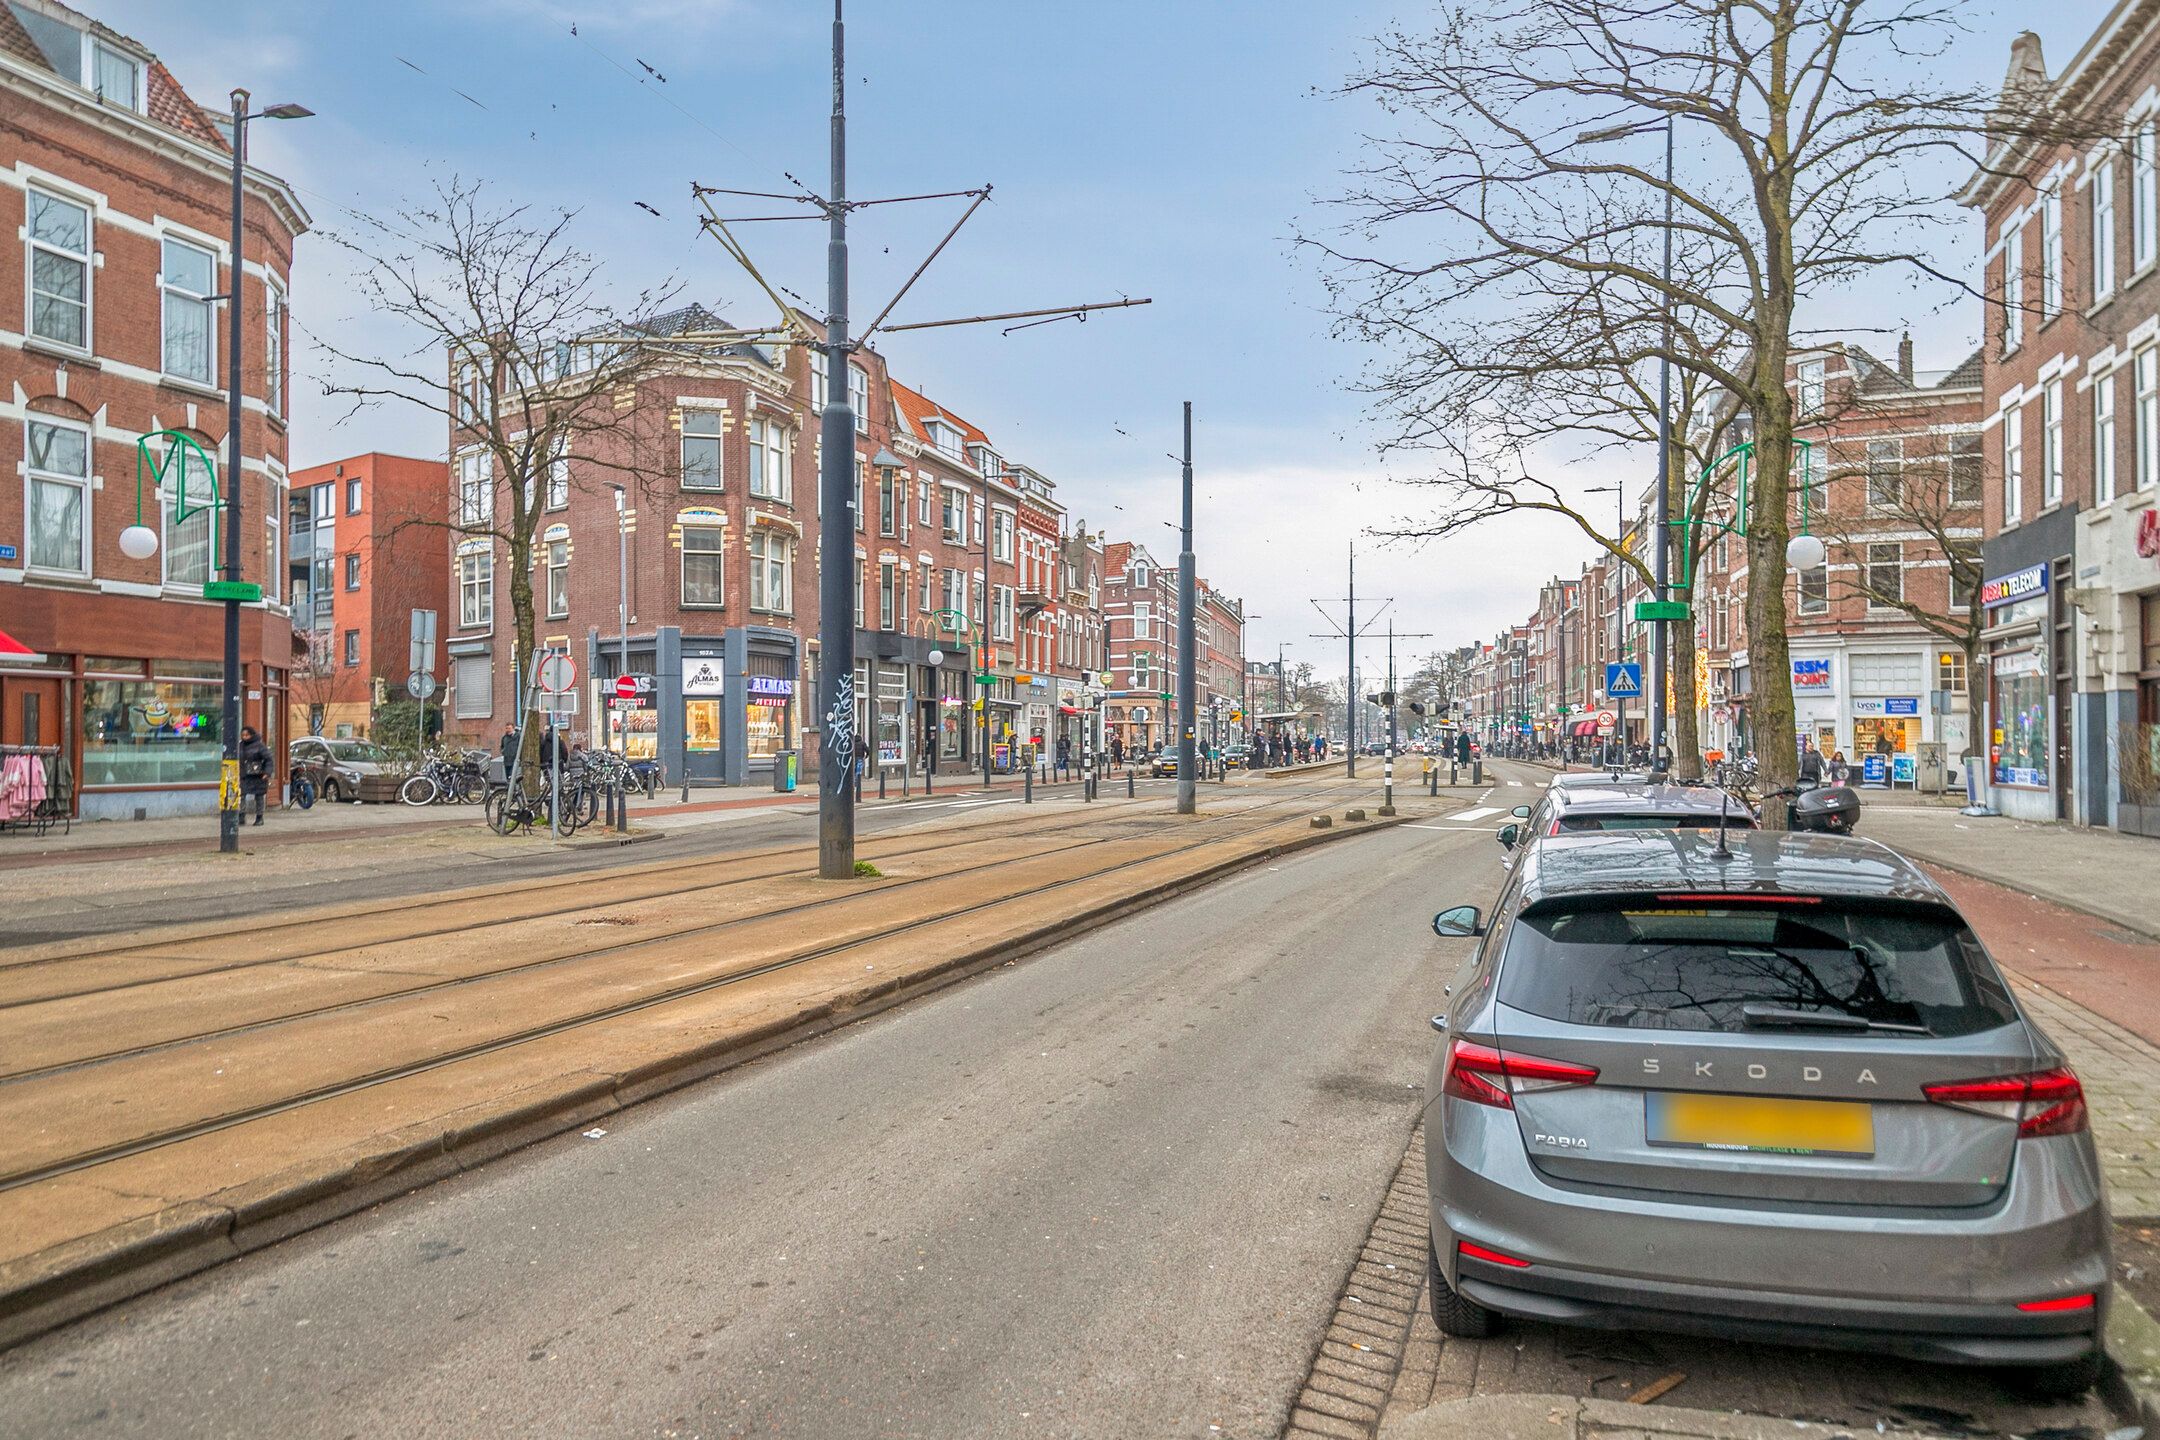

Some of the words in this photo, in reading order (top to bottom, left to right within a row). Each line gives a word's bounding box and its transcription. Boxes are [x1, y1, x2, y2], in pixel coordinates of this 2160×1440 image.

[2008, 568, 2042, 596] TELECOM
[1794, 660, 1829, 674] GSM
[687, 674, 720, 689] ALMAS
[752, 677, 792, 695] ALMAS
[1793, 673, 1830, 685] POINT
[1857, 701, 1876, 710] Lyca
[1643, 1058, 1877, 1084] SKODA
[1535, 1133, 1588, 1148] FABIA
